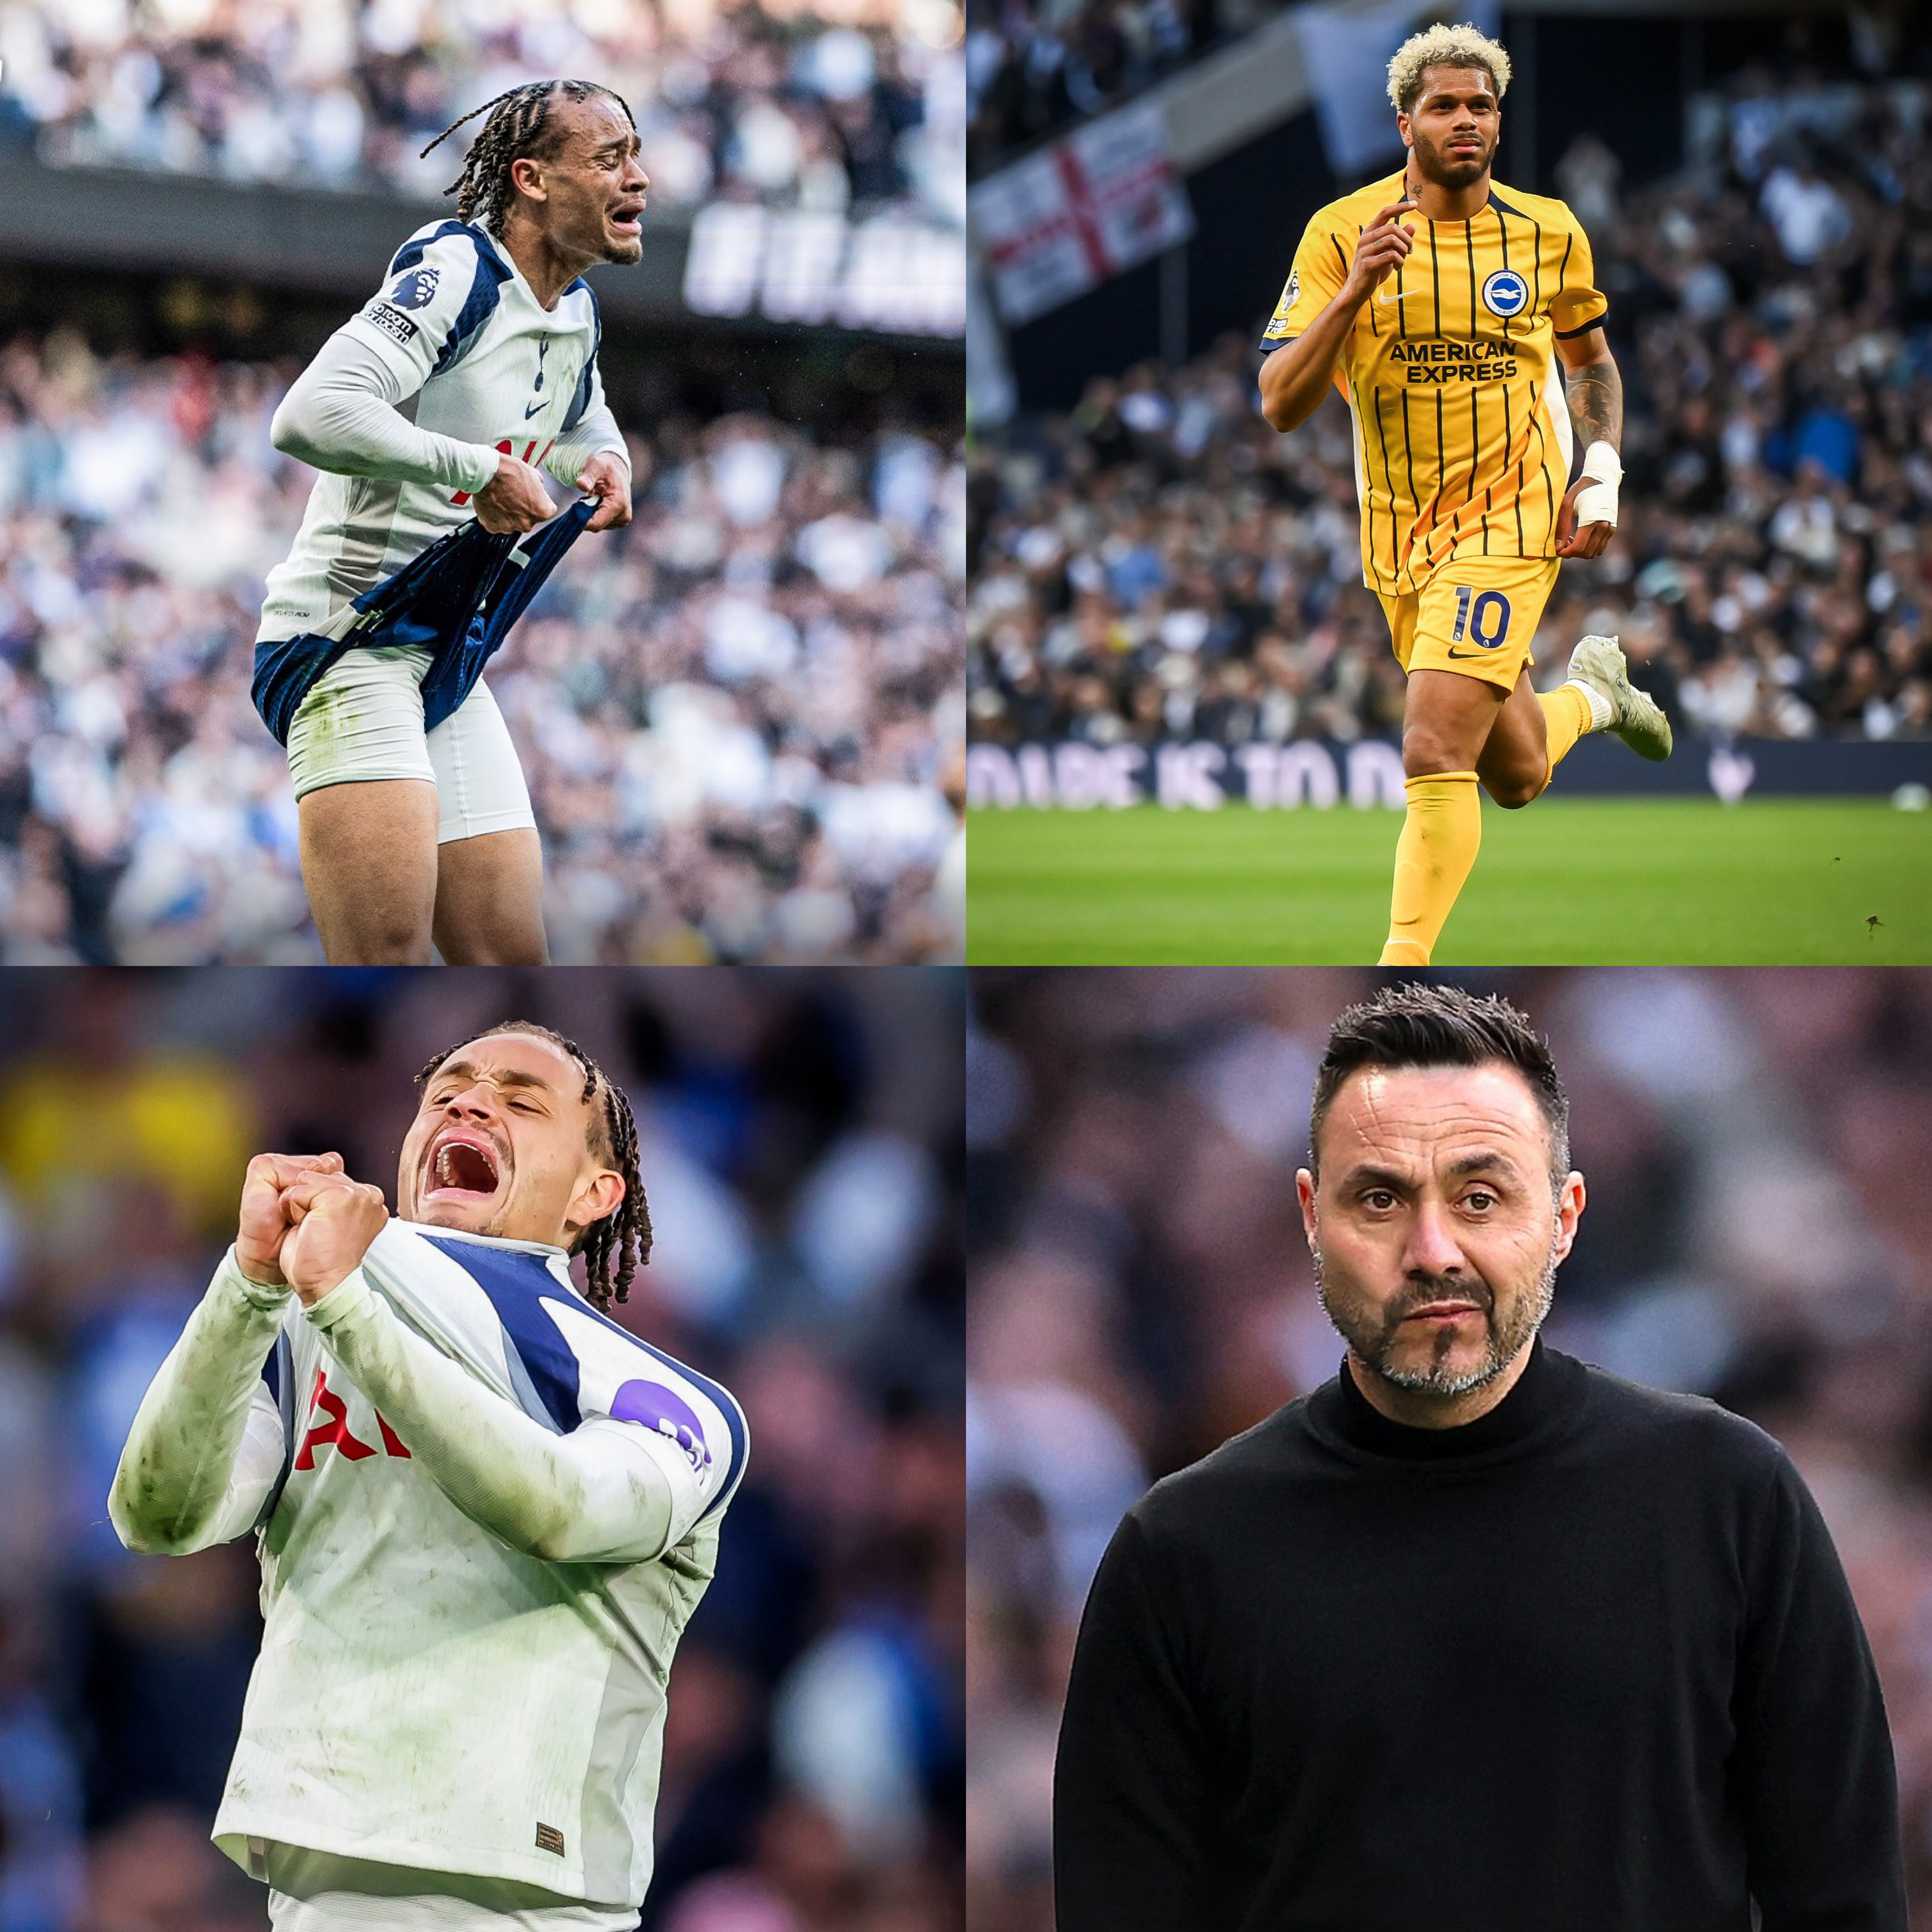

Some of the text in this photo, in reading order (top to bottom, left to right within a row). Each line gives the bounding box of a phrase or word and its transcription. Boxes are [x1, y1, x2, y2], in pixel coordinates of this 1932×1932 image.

[1389, 341, 1518, 362] AMERICAN
[1407, 359, 1517, 383] EXPRESS
[1452, 586, 1511, 649] 10
